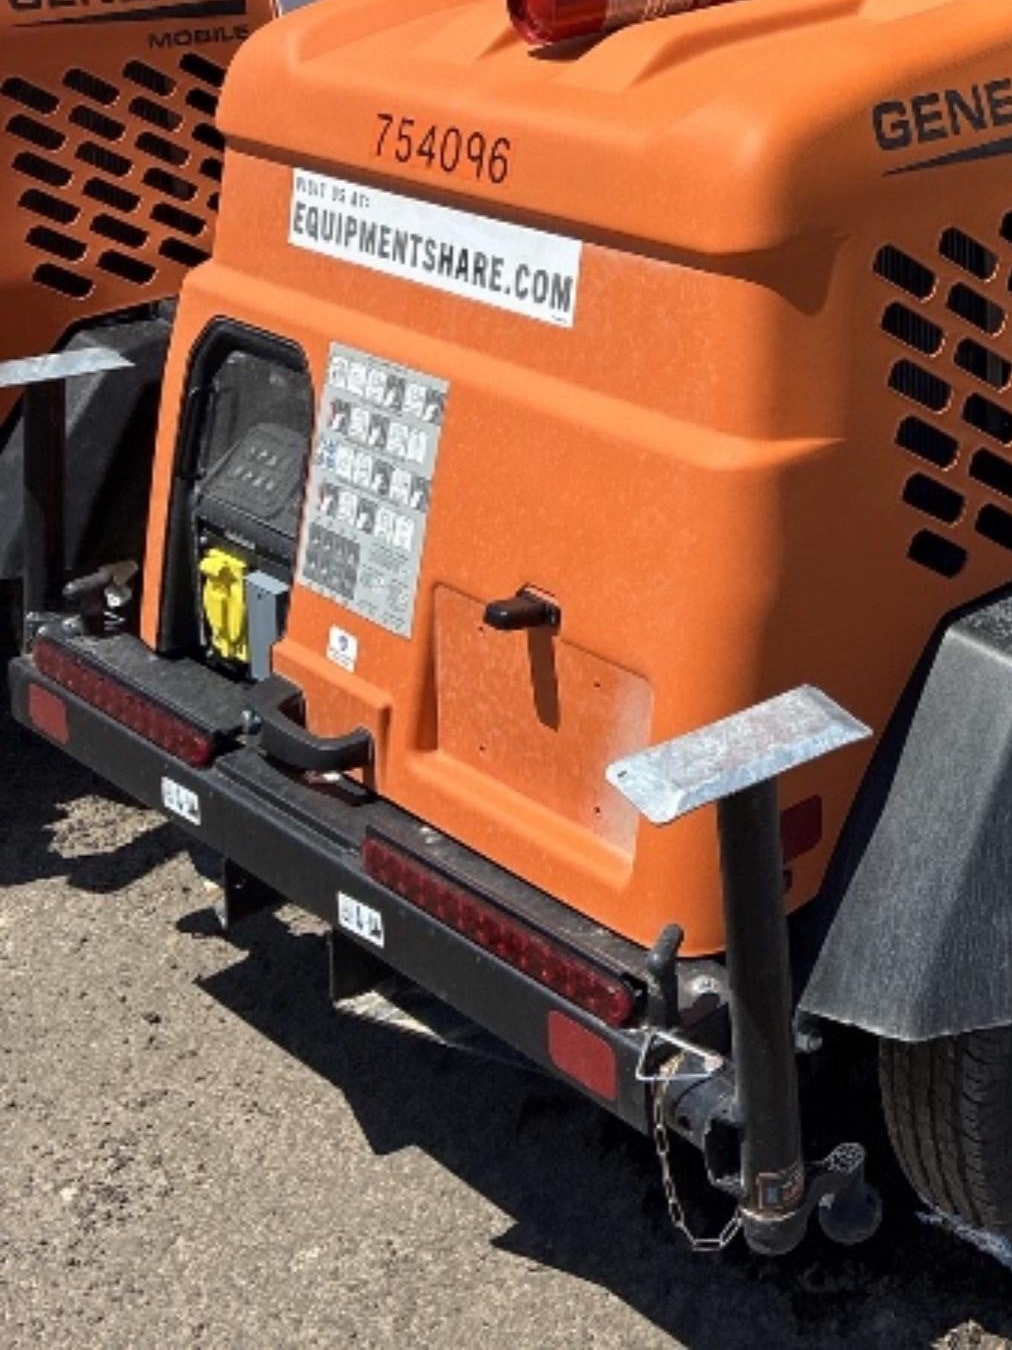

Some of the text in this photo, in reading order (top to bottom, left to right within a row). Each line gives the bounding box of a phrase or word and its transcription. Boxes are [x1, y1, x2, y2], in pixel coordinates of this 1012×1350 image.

[149, 24, 250, 49] MOBILE
[374, 113, 512, 185] 754096
[292, 200, 574, 314] EQUIPMENTSHARE.COM
